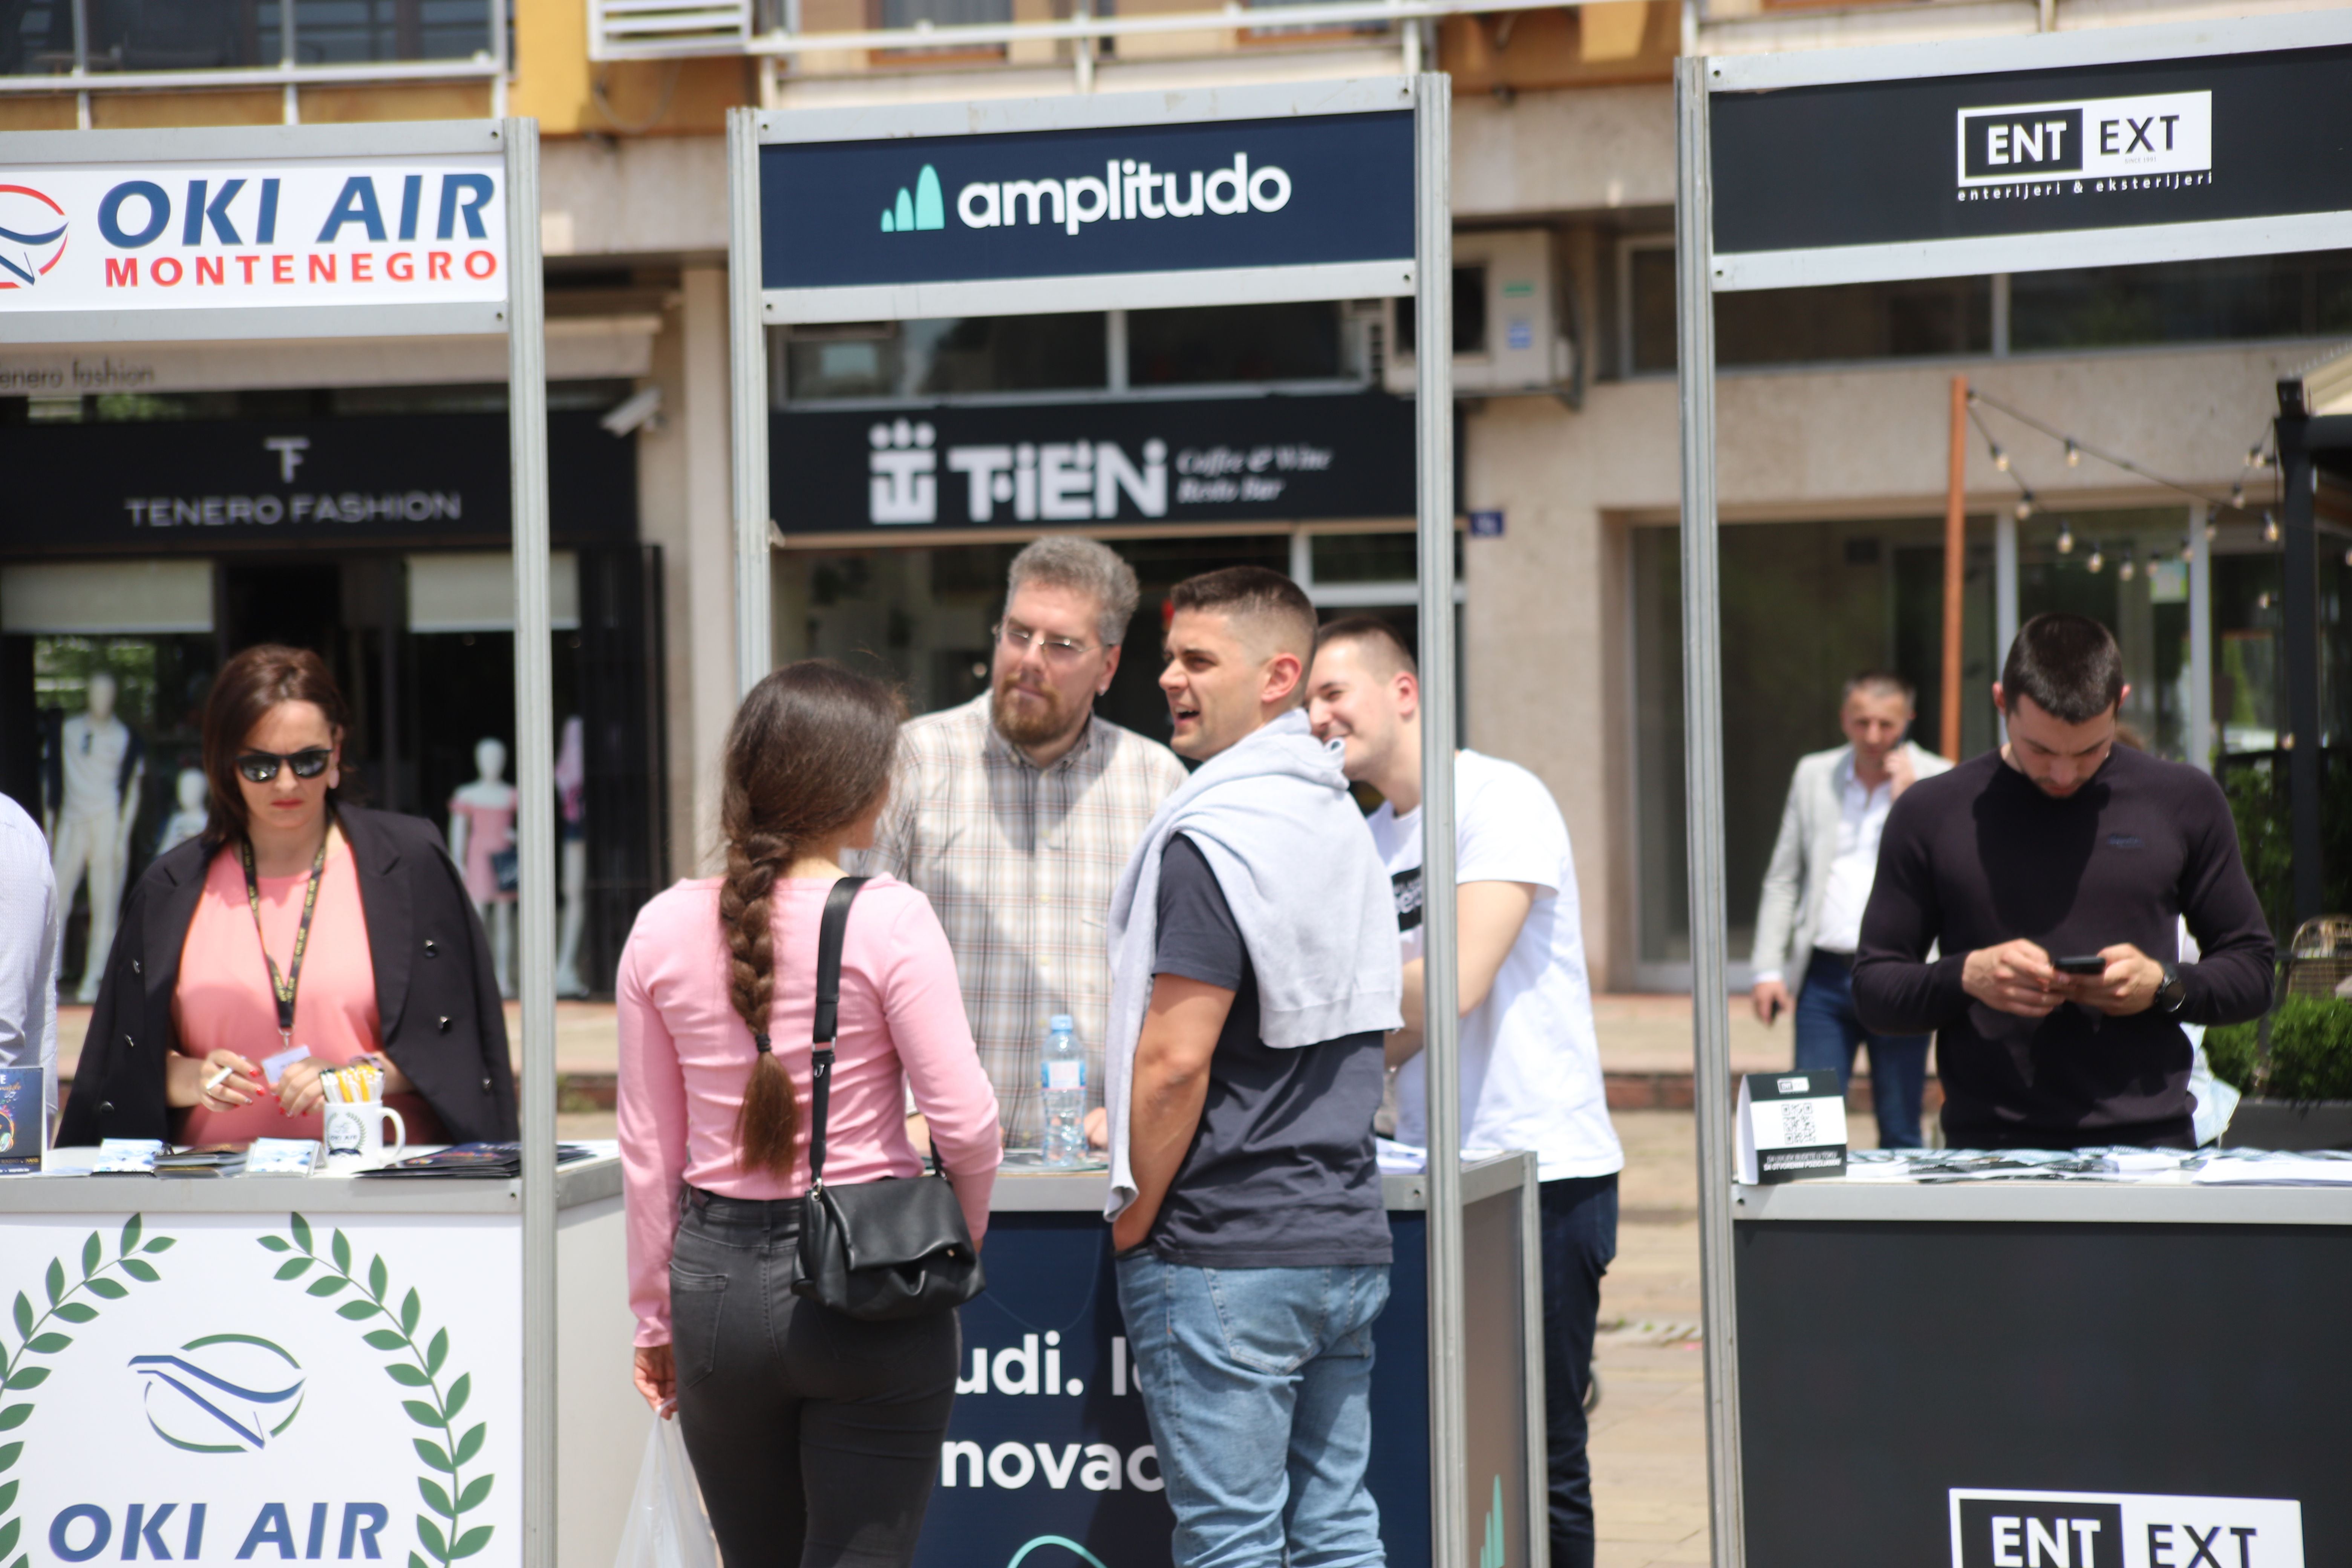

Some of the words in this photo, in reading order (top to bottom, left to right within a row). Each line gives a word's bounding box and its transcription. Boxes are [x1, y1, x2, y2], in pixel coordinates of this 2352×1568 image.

[1988, 120, 2068, 165] ENT
[2100, 115, 2180, 155] EXT
[957, 153, 1292, 235] amplitudo
[1958, 181, 2060, 201] enterijeri
[2073, 180, 2083, 194] &
[2096, 170, 2212, 192] eksterijeri
[97, 178, 279, 248] OKI
[315, 173, 495, 242] AIR
[105, 250, 498, 288] MONTENEGRO
[1176, 446, 1244, 477] Coffee
[1247, 445, 1274, 472] &
[1276, 444, 1333, 471] Wine
[125, 495, 283, 527] TENERO
[290, 491, 462, 523] FASHION
[1240, 474, 1286, 502] Bar
[49, 1503, 207, 1563] OKI
[234, 1502, 389, 1560] AIR
[1991, 1516, 2101, 1568] ENT
[2147, 1524, 2257, 1568] EXT
